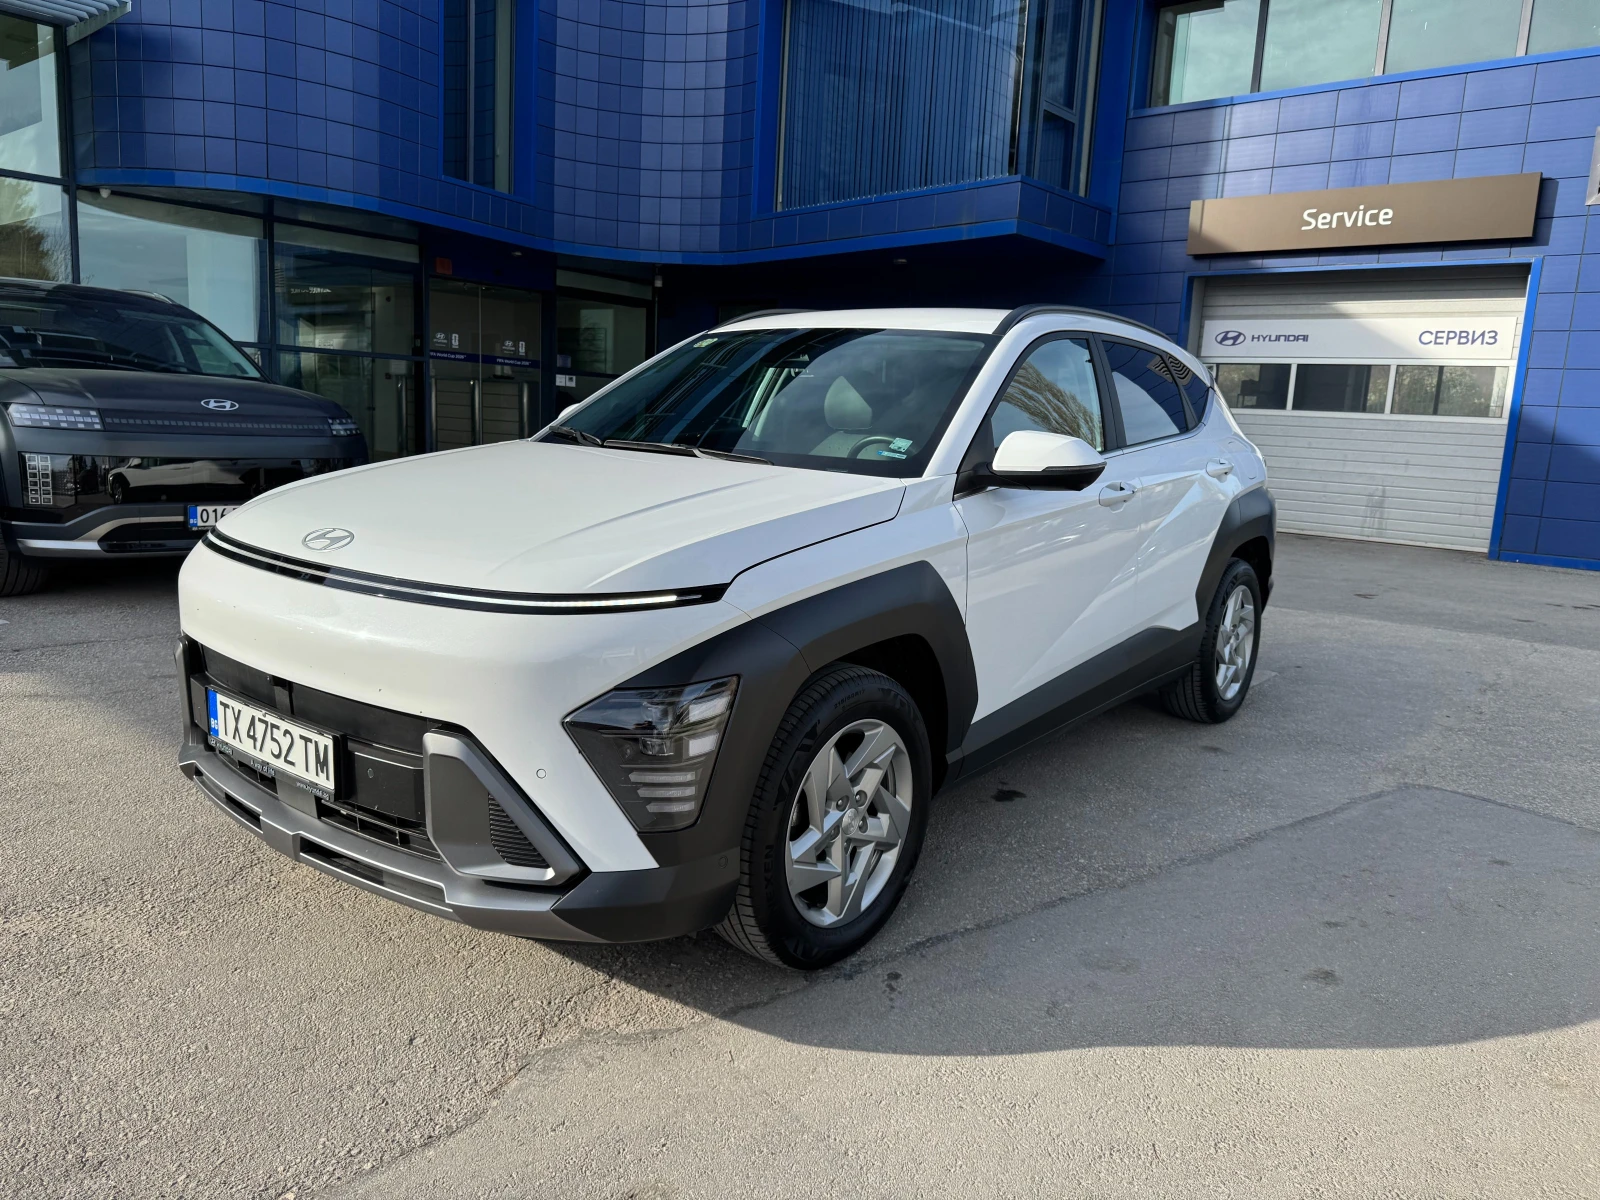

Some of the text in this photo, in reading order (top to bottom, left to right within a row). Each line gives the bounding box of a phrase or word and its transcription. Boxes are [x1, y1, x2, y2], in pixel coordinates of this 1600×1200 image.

[1301, 204, 1394, 231] Service
[1251, 334, 1309, 343] HYUNDAI
[1418, 330, 1499, 346] СЕРВИЗ
[210, 717, 219, 730] BG
[246, 714, 297, 767] 4752
